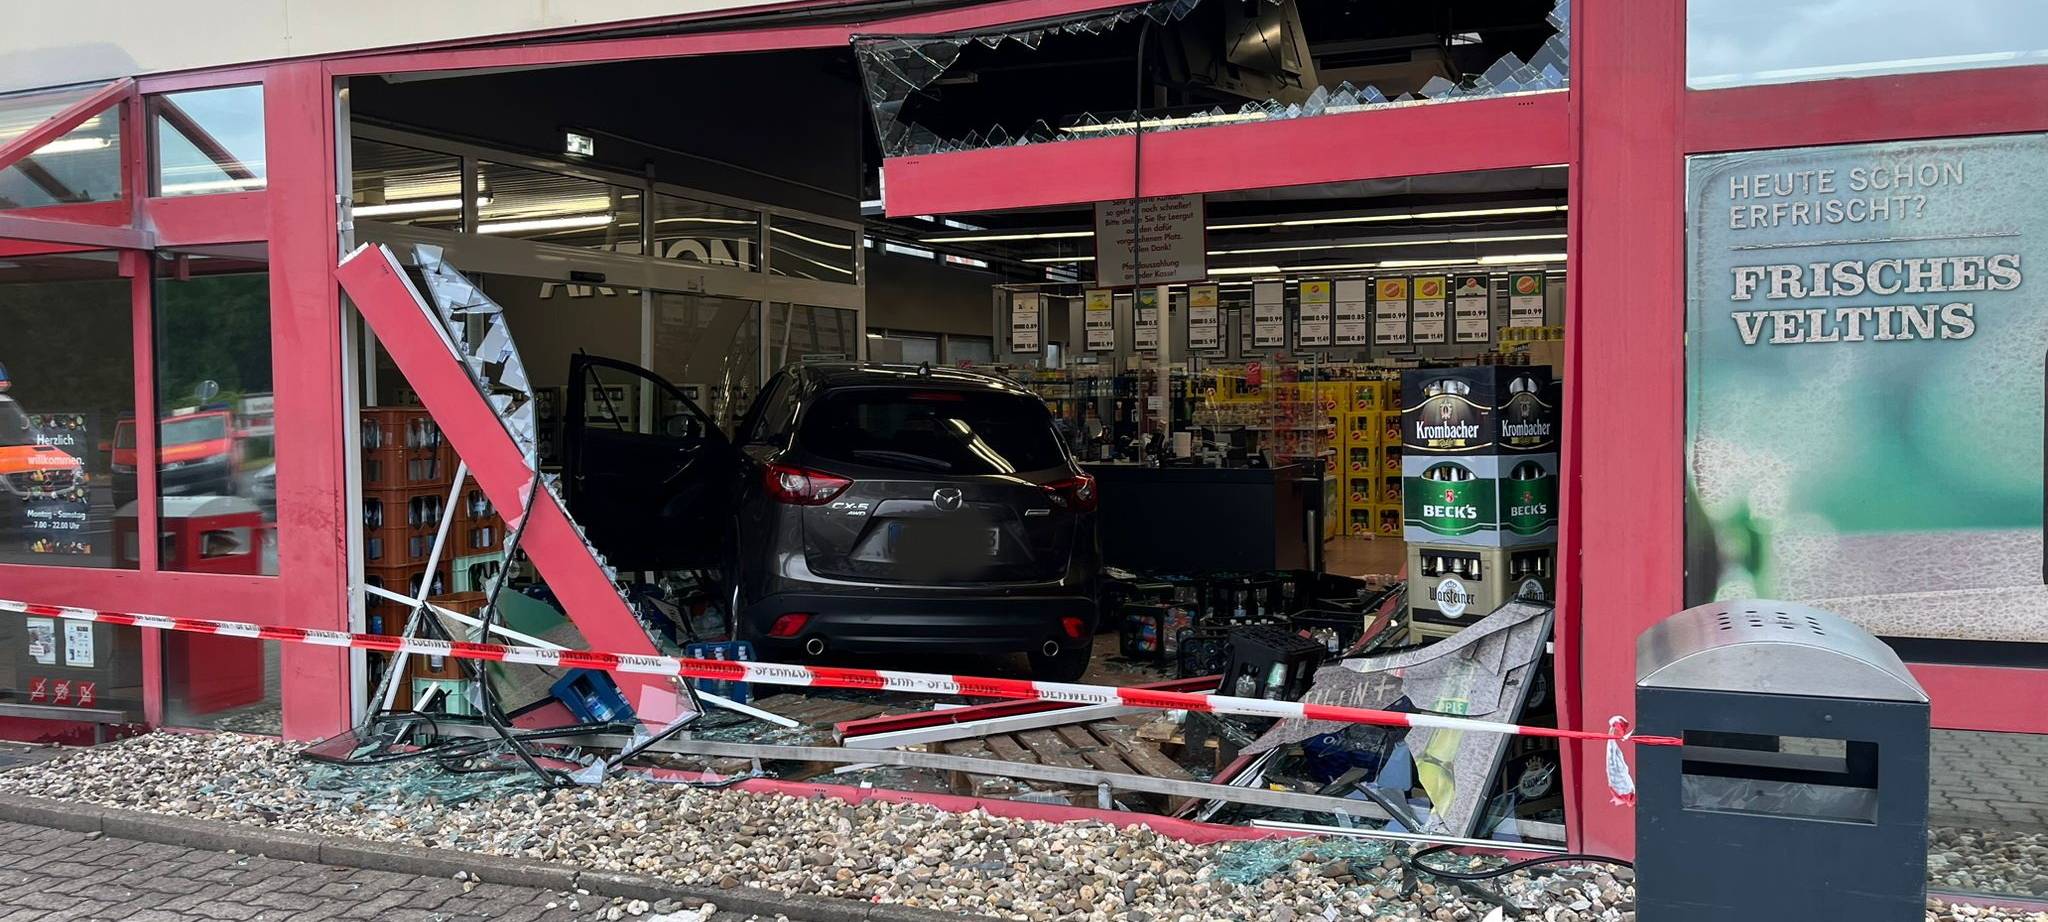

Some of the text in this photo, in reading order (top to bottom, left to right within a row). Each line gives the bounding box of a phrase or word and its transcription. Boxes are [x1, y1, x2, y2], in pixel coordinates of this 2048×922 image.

[1729, 160, 1965, 199] HEUTE SCHON
[1141, 203, 1158, 213] noch
[1729, 195, 1928, 229] ERFRISCHT?
[1144, 215, 1155, 223] Sie
[1151, 243, 1172, 252] Dank!
[1730, 254, 2022, 301] FRISCHES
[1731, 303, 1976, 345] VELTINS
[1416, 420, 1480, 439] Krombacher
[1502, 418, 1551, 437] Krombacher
[36, 433, 74, 446] Herzlich
[831, 502, 870, 510] CX-5
[1423, 504, 1478, 519] BECK'S
[1511, 503, 1547, 517] BECK'S
[27, 509, 52, 520] Montag
[57, 510, 86, 520] Samstag
[69, 521, 80, 530] Uhr
[1429, 586, 1475, 605] Warsteiner
